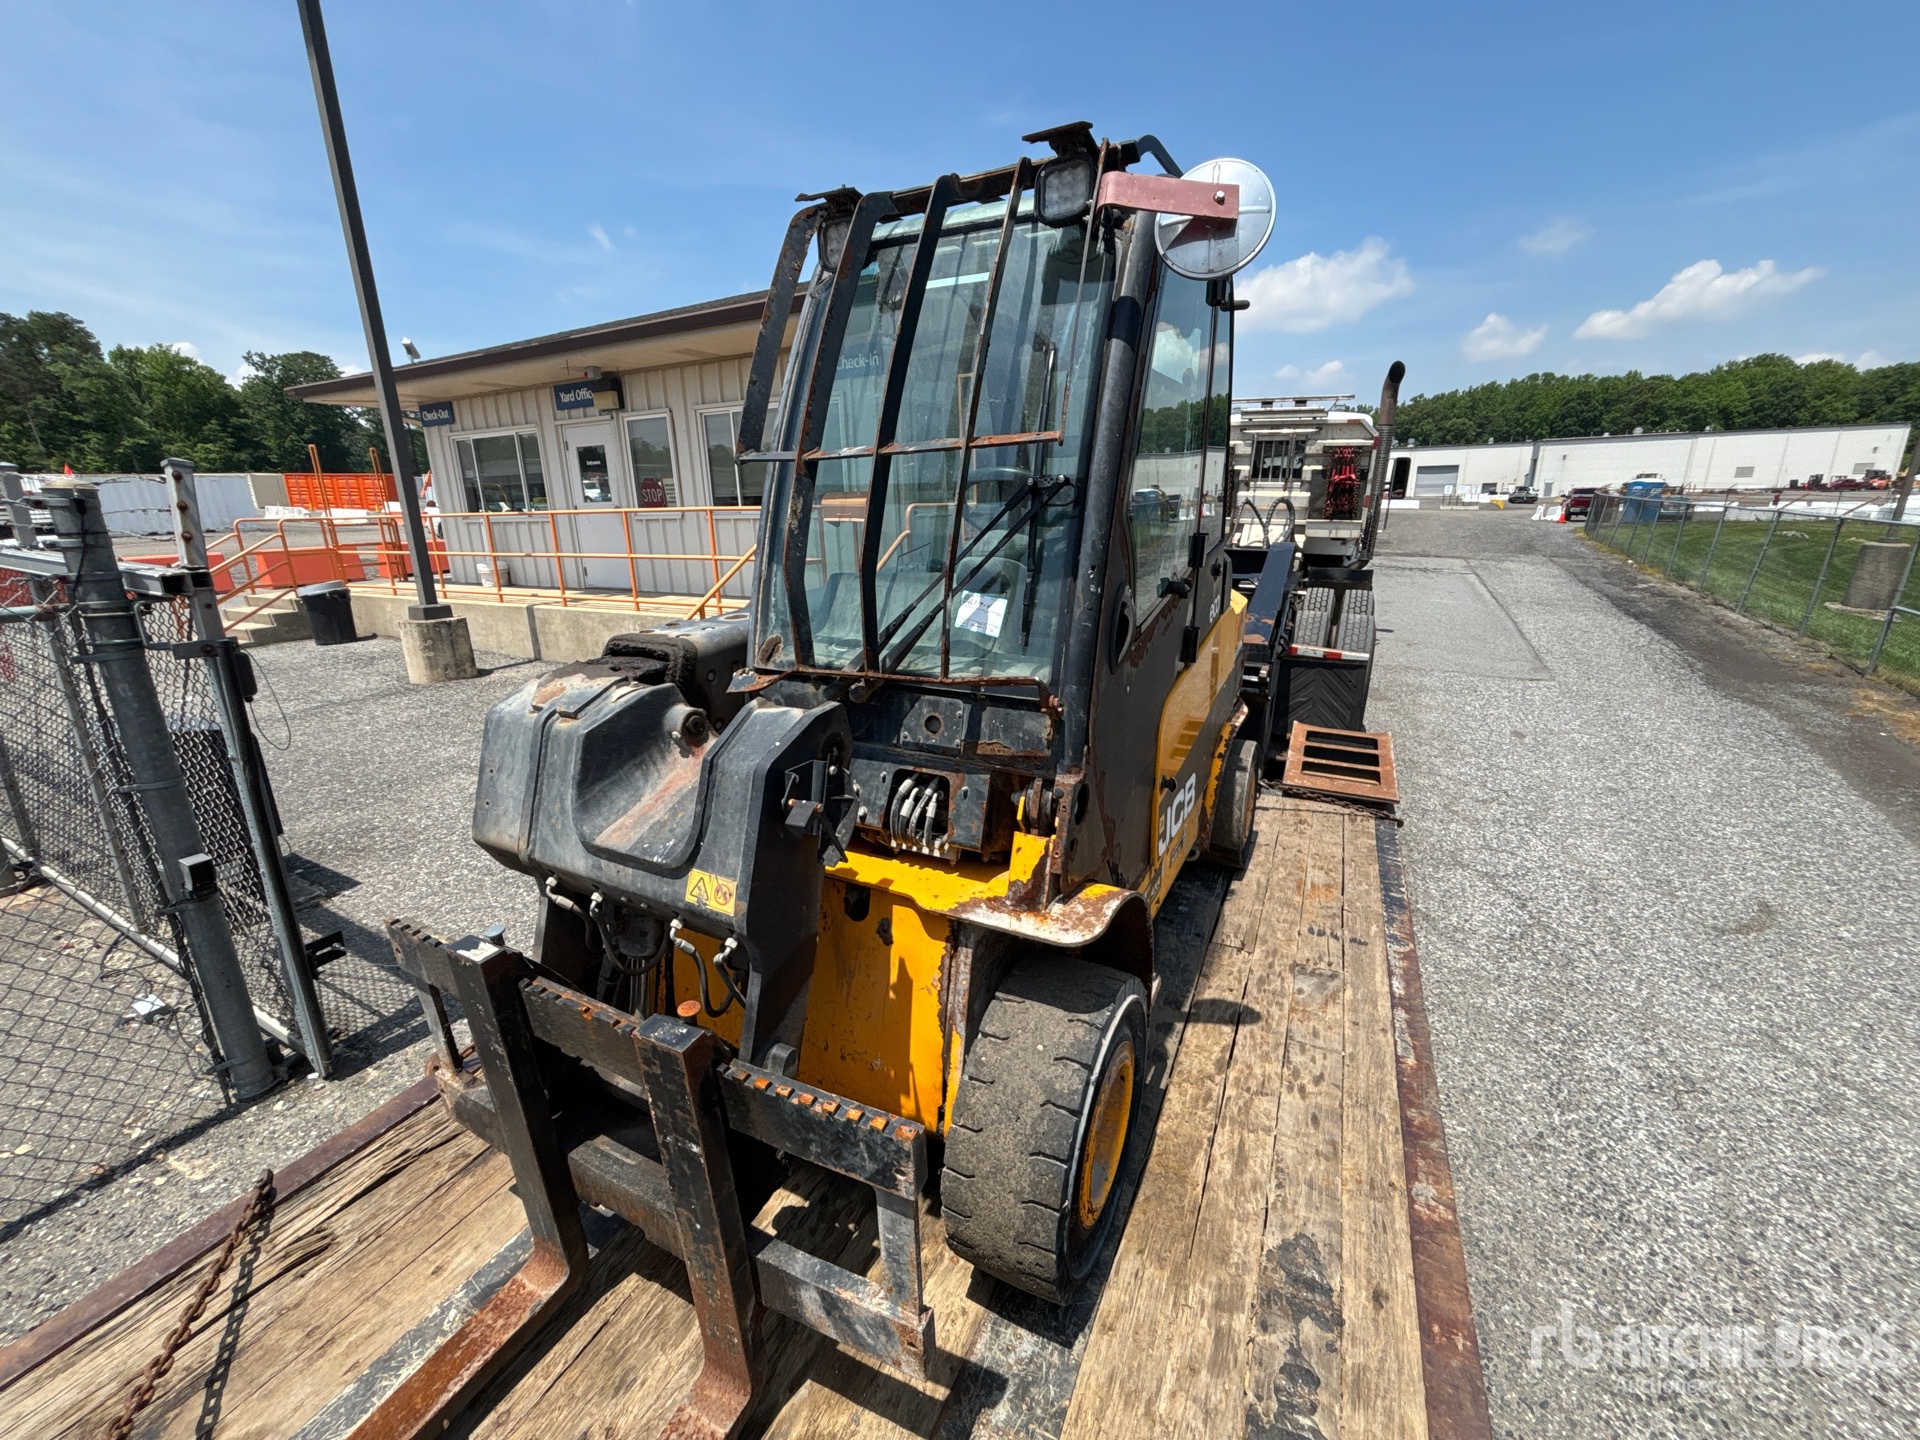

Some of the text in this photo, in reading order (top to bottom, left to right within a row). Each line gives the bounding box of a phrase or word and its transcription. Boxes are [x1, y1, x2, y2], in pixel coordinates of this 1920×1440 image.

[559, 387, 594, 403] Yard Offic
[422, 409, 450, 421] Check-Out
[641, 488, 663, 502] STOP
[1158, 772, 1196, 857] JCB
